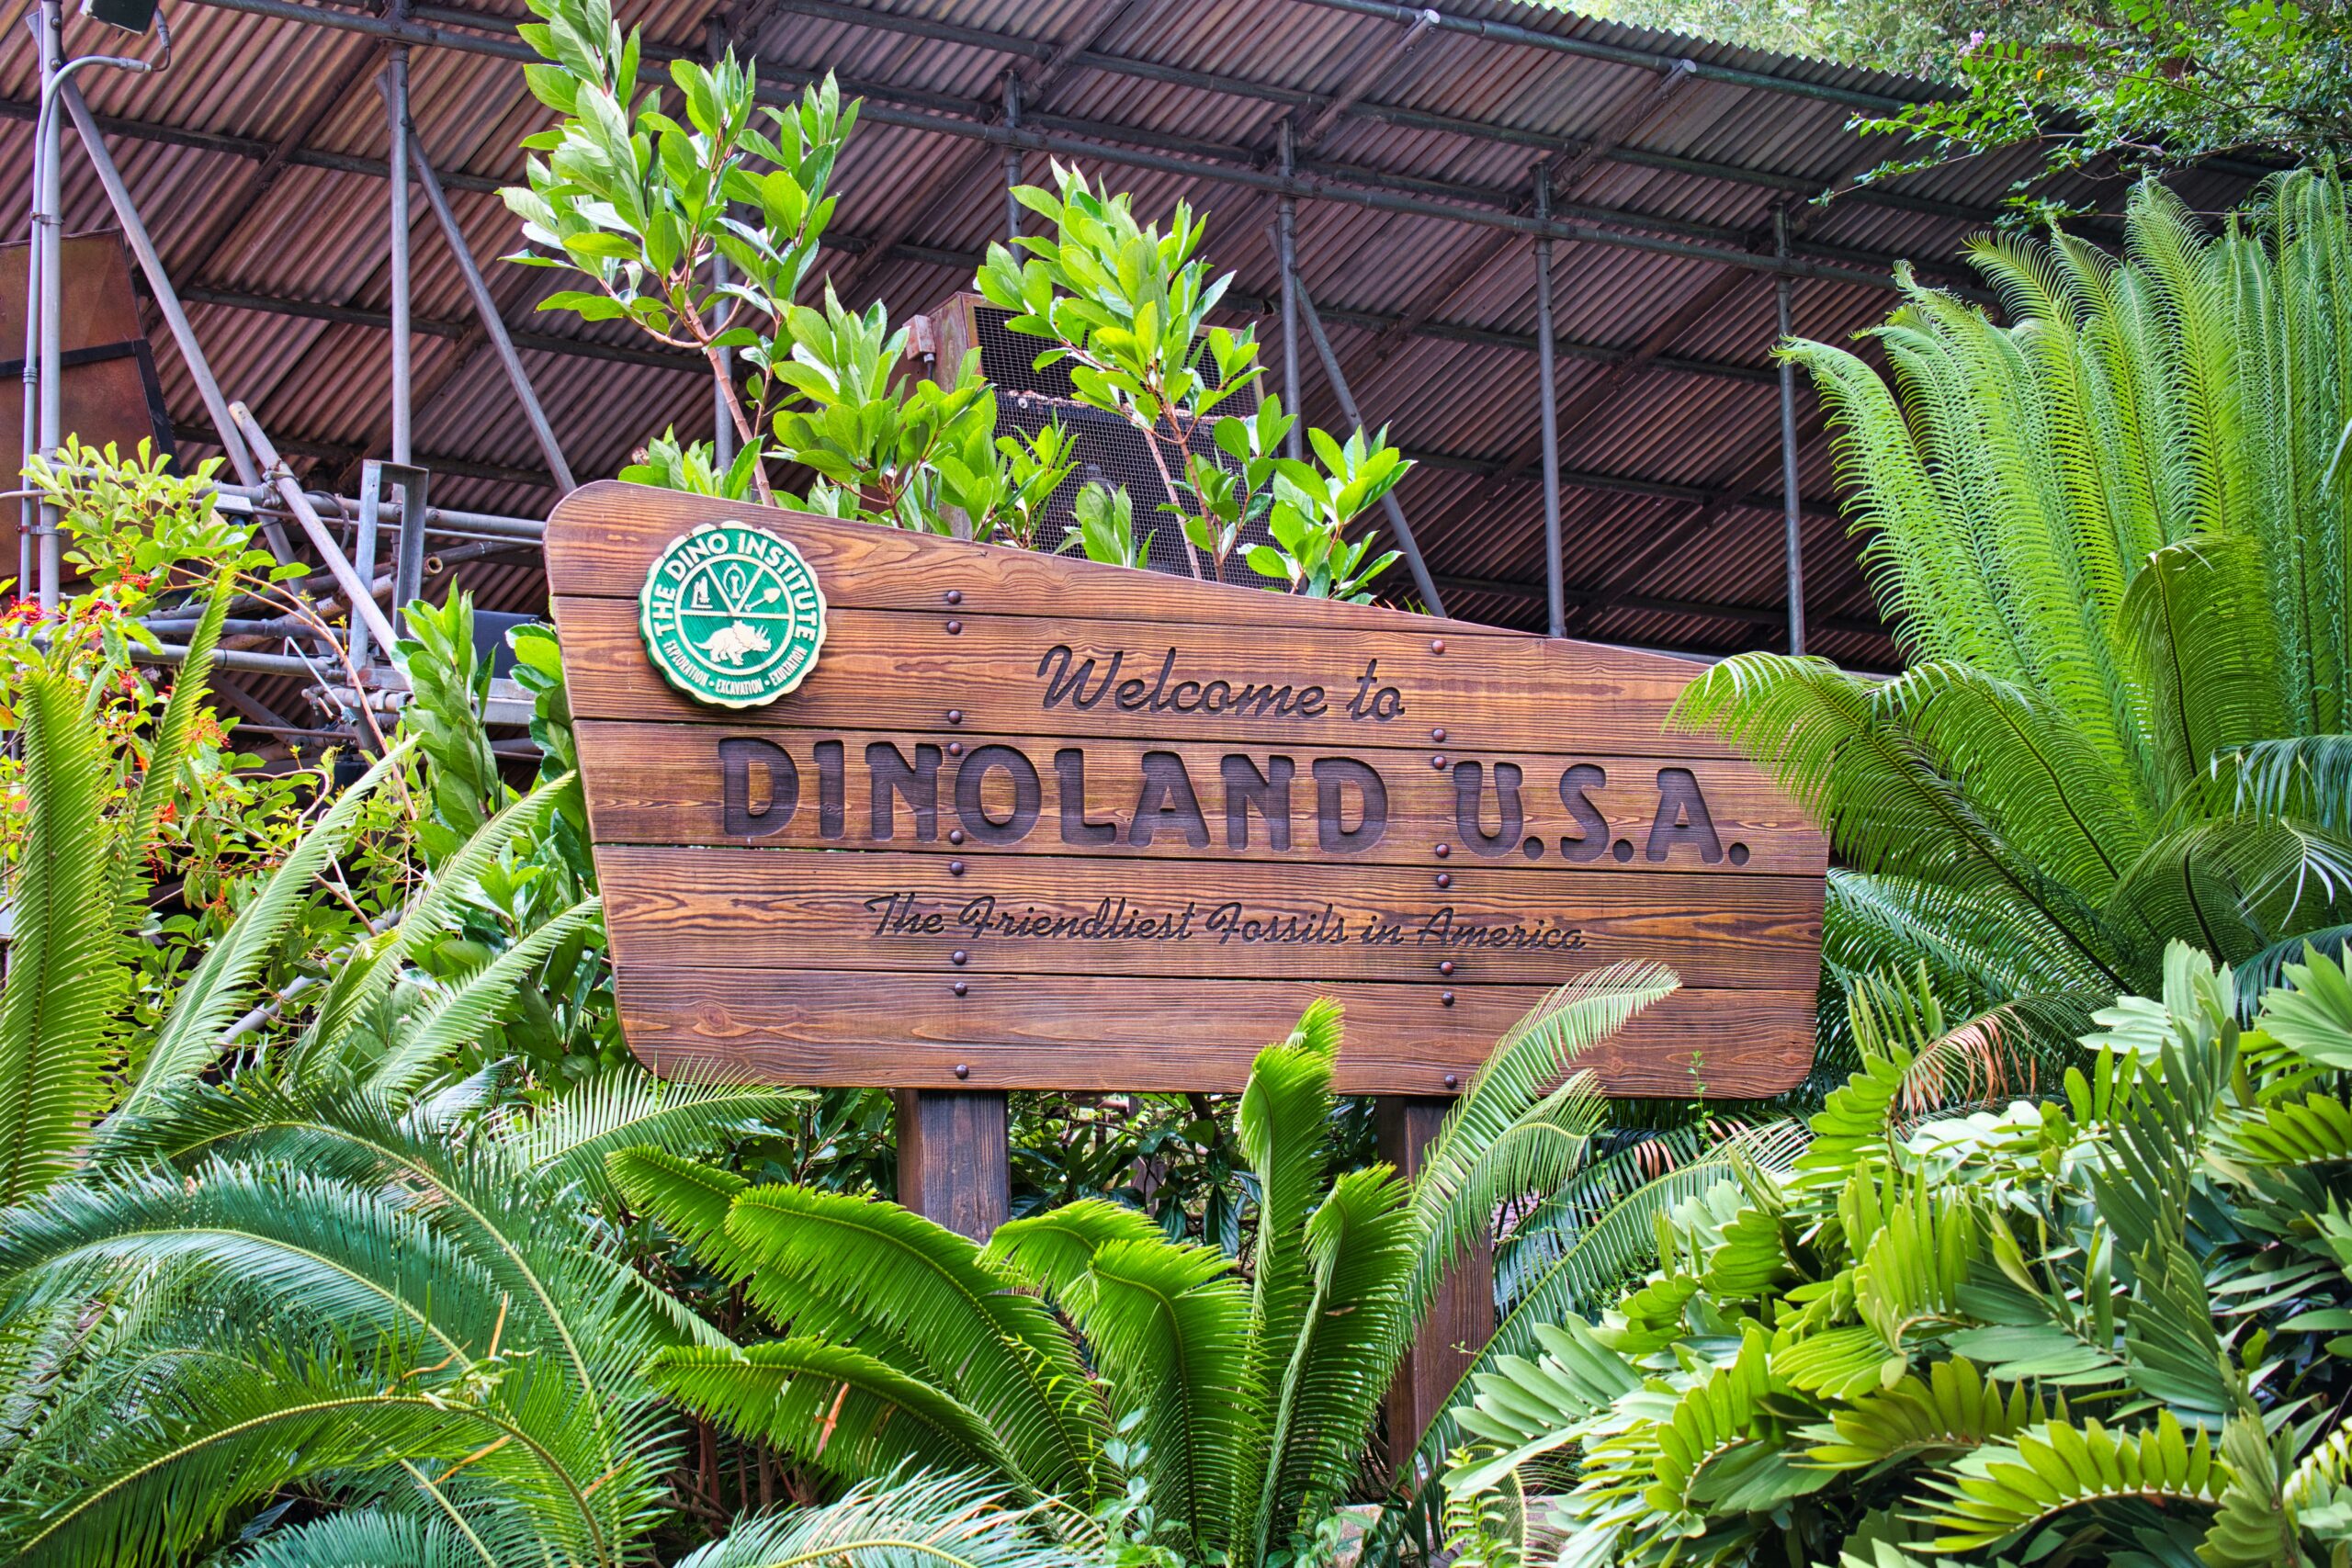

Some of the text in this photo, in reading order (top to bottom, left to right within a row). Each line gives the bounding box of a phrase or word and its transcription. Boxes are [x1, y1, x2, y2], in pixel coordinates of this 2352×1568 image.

[652, 533, 818, 641] THE DINO INSTITUTE
[664, 639, 808, 695] EXPLORATION EXCAVATION EXULTATION
[1037, 645, 1406, 722] Welcome to
[718, 737, 1751, 865] DINOLAND U.S.A.
[864, 892, 1587, 951] The Friendliest Fossils in America
